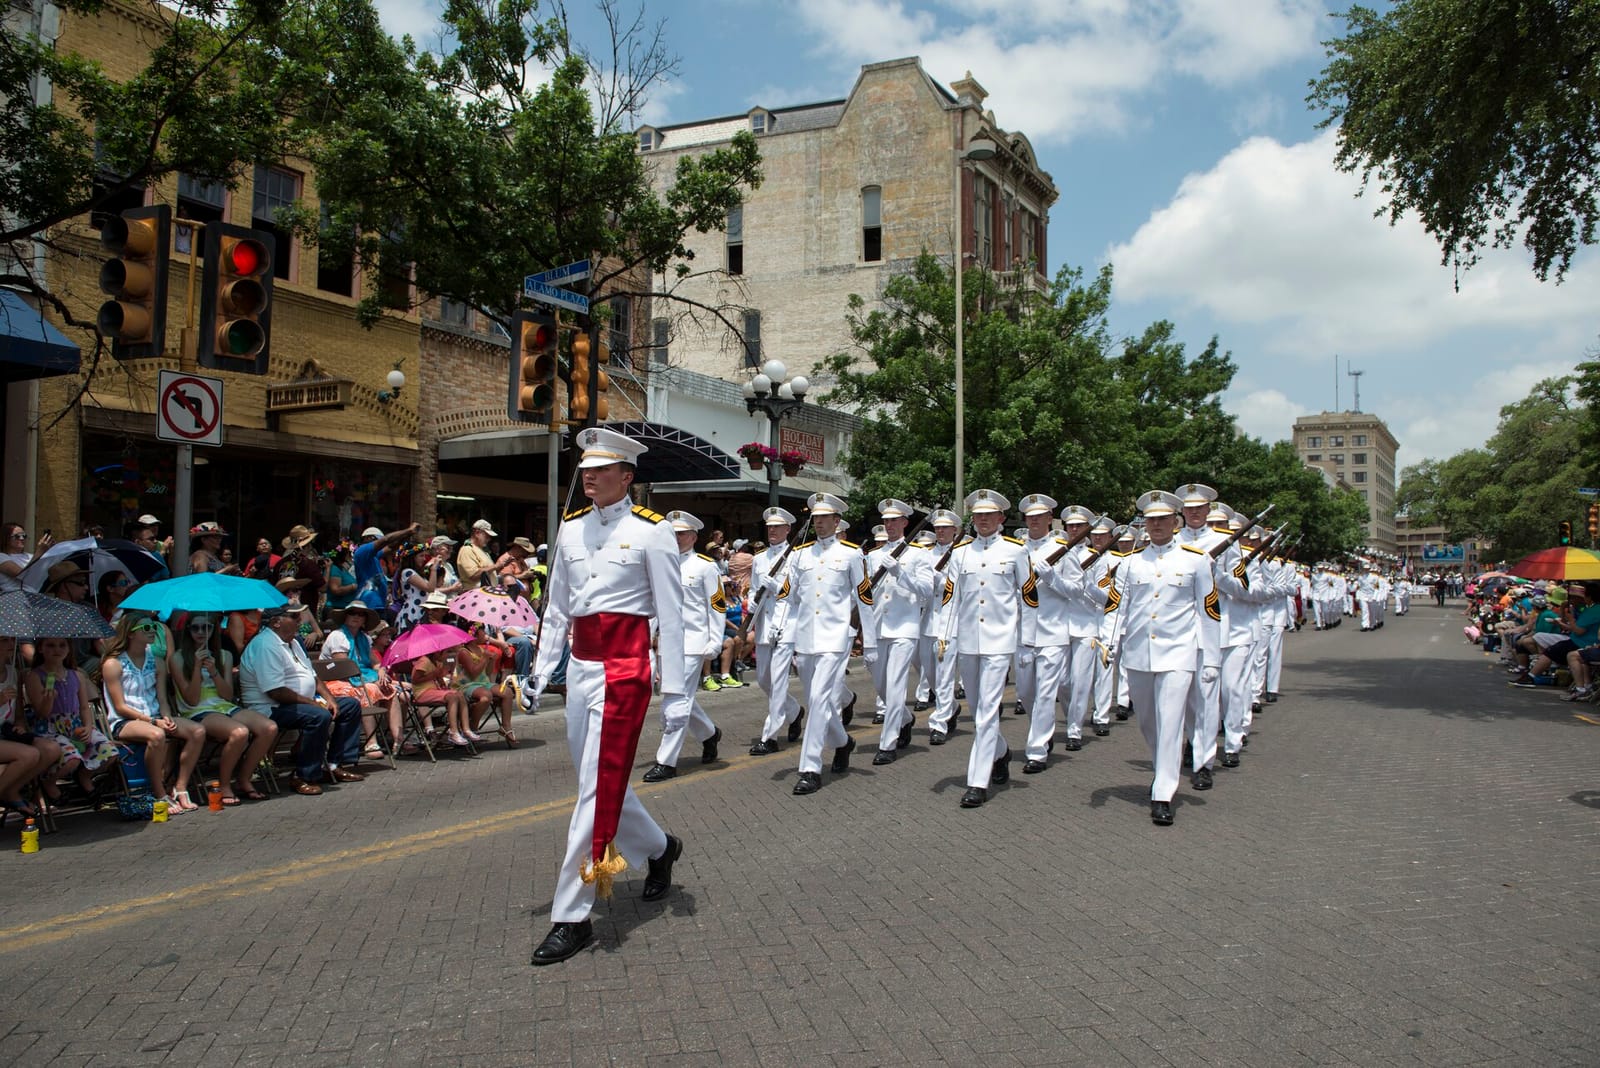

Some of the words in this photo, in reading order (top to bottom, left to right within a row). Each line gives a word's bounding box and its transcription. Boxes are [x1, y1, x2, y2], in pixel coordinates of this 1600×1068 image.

[544, 265, 570, 281] BLUM
[527, 280, 558, 297] ALAMO
[560, 288, 587, 308] PLAZA
[307, 384, 338, 402] DRUGS
[783, 430, 822, 448] HOLIDAY
